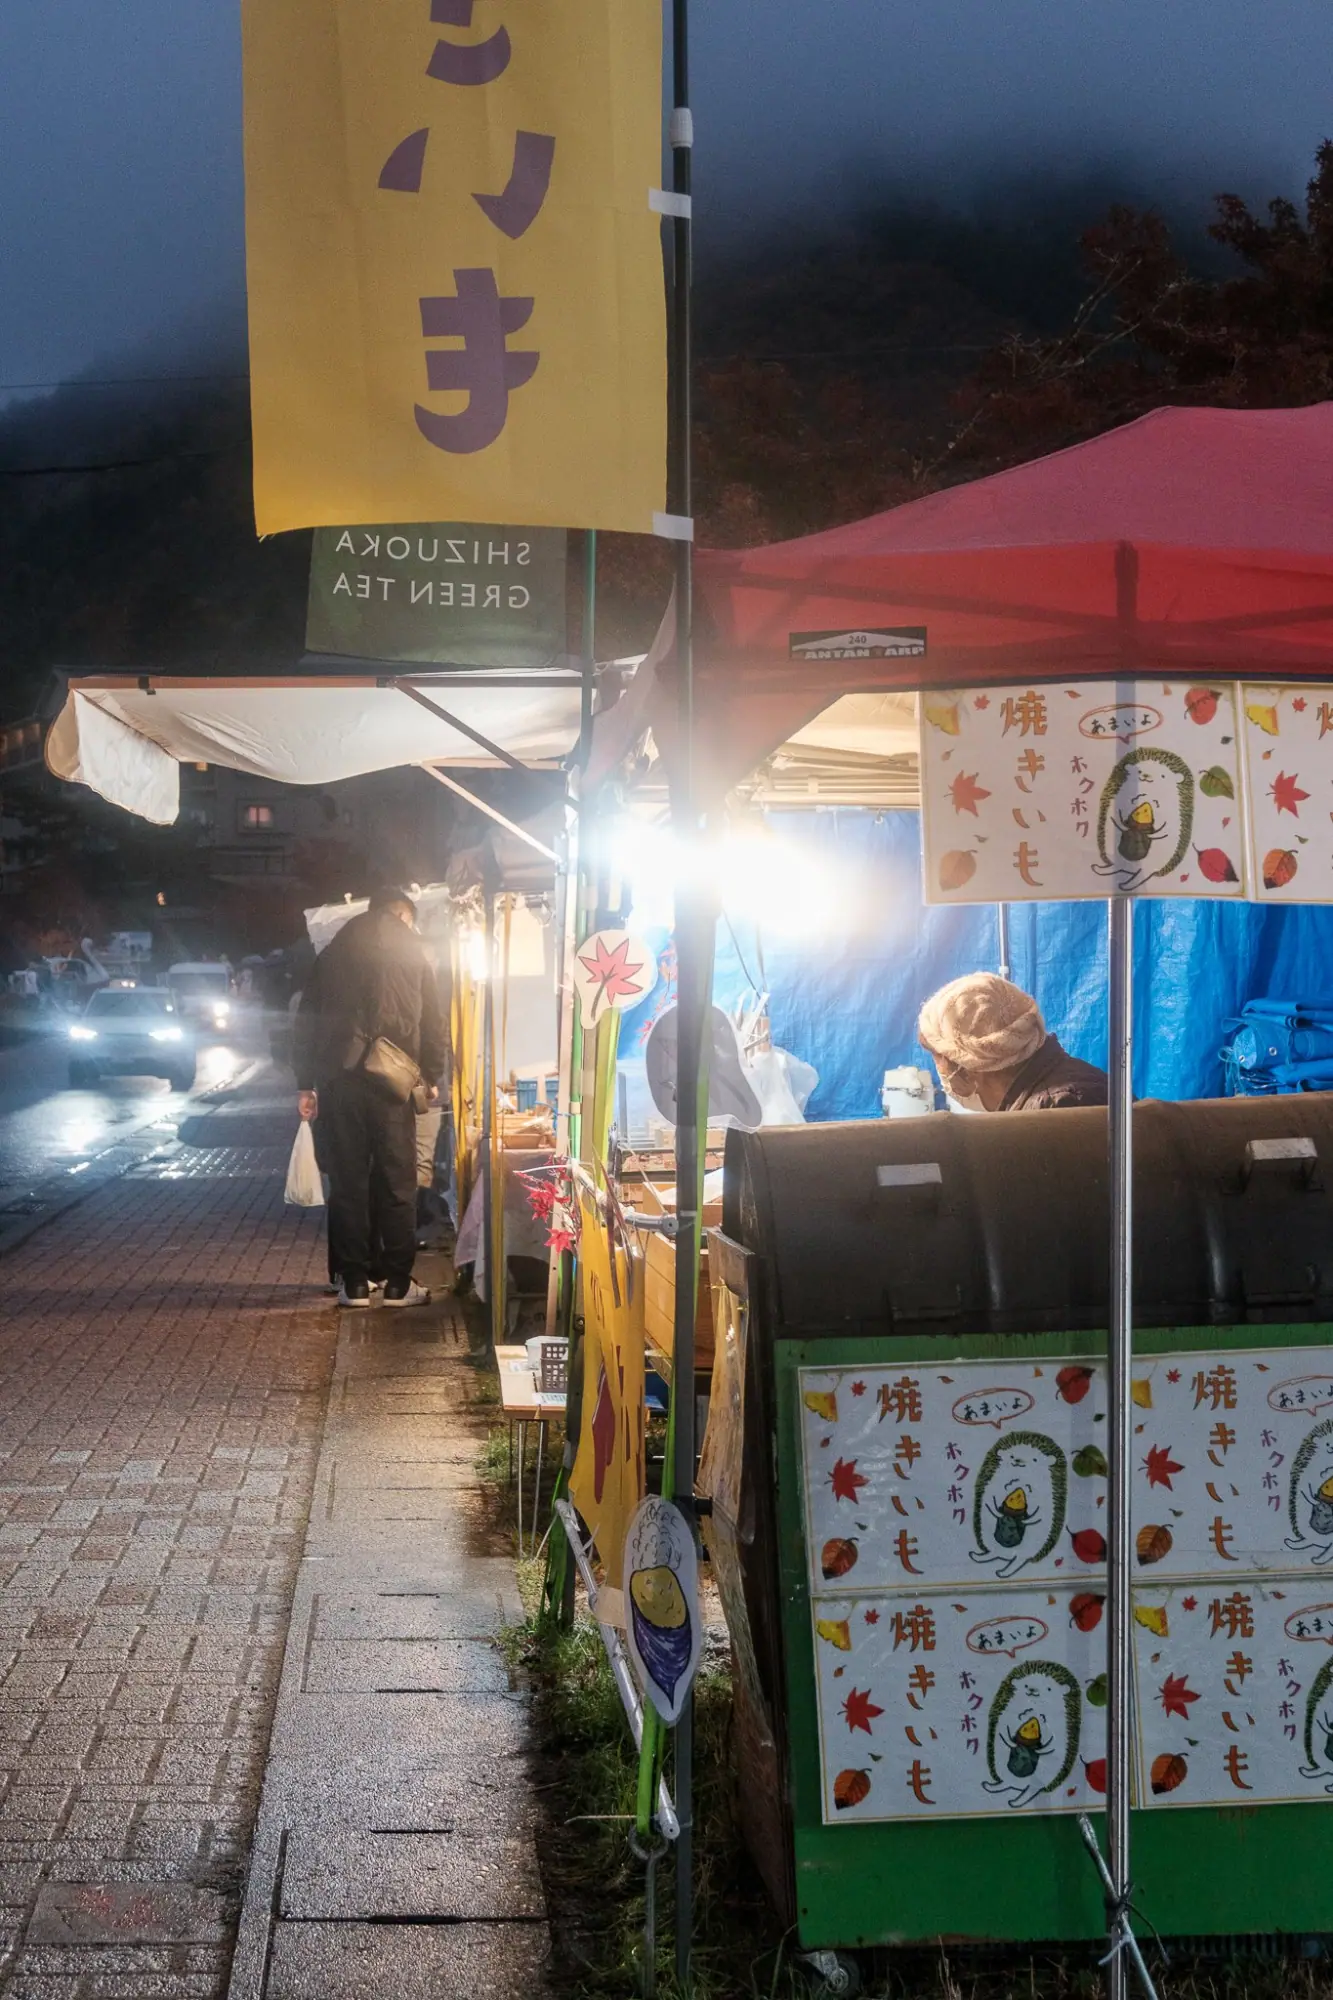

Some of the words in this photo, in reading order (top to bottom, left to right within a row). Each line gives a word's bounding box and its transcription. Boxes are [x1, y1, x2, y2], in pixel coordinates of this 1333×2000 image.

[794, 648, 870, 660] ANTAN
[848, 635, 868, 645] 240
[1091, 714, 1152, 735] あまいよ
[999, 690, 1048, 887] 焼きいも
[1070, 755, 1095, 838] ホクホク
[964, 1397, 1023, 1421] あまいよ
[876, 1376, 925, 1574] 焼きいも
[945, 1442, 970, 1525] ホクホク
[1190, 1364, 1239, 1561] 焼きいも
[1260, 1428, 1285, 1512] ホクホク
[978, 1625, 1037, 1650] あまいよ
[889, 1604, 938, 1805] 焼きいも
[959, 1671, 984, 1755] ホクホク
[1207, 1592, 1254, 1789] 焼きいも
[1277, 1658, 1301, 1741] ホクホク
